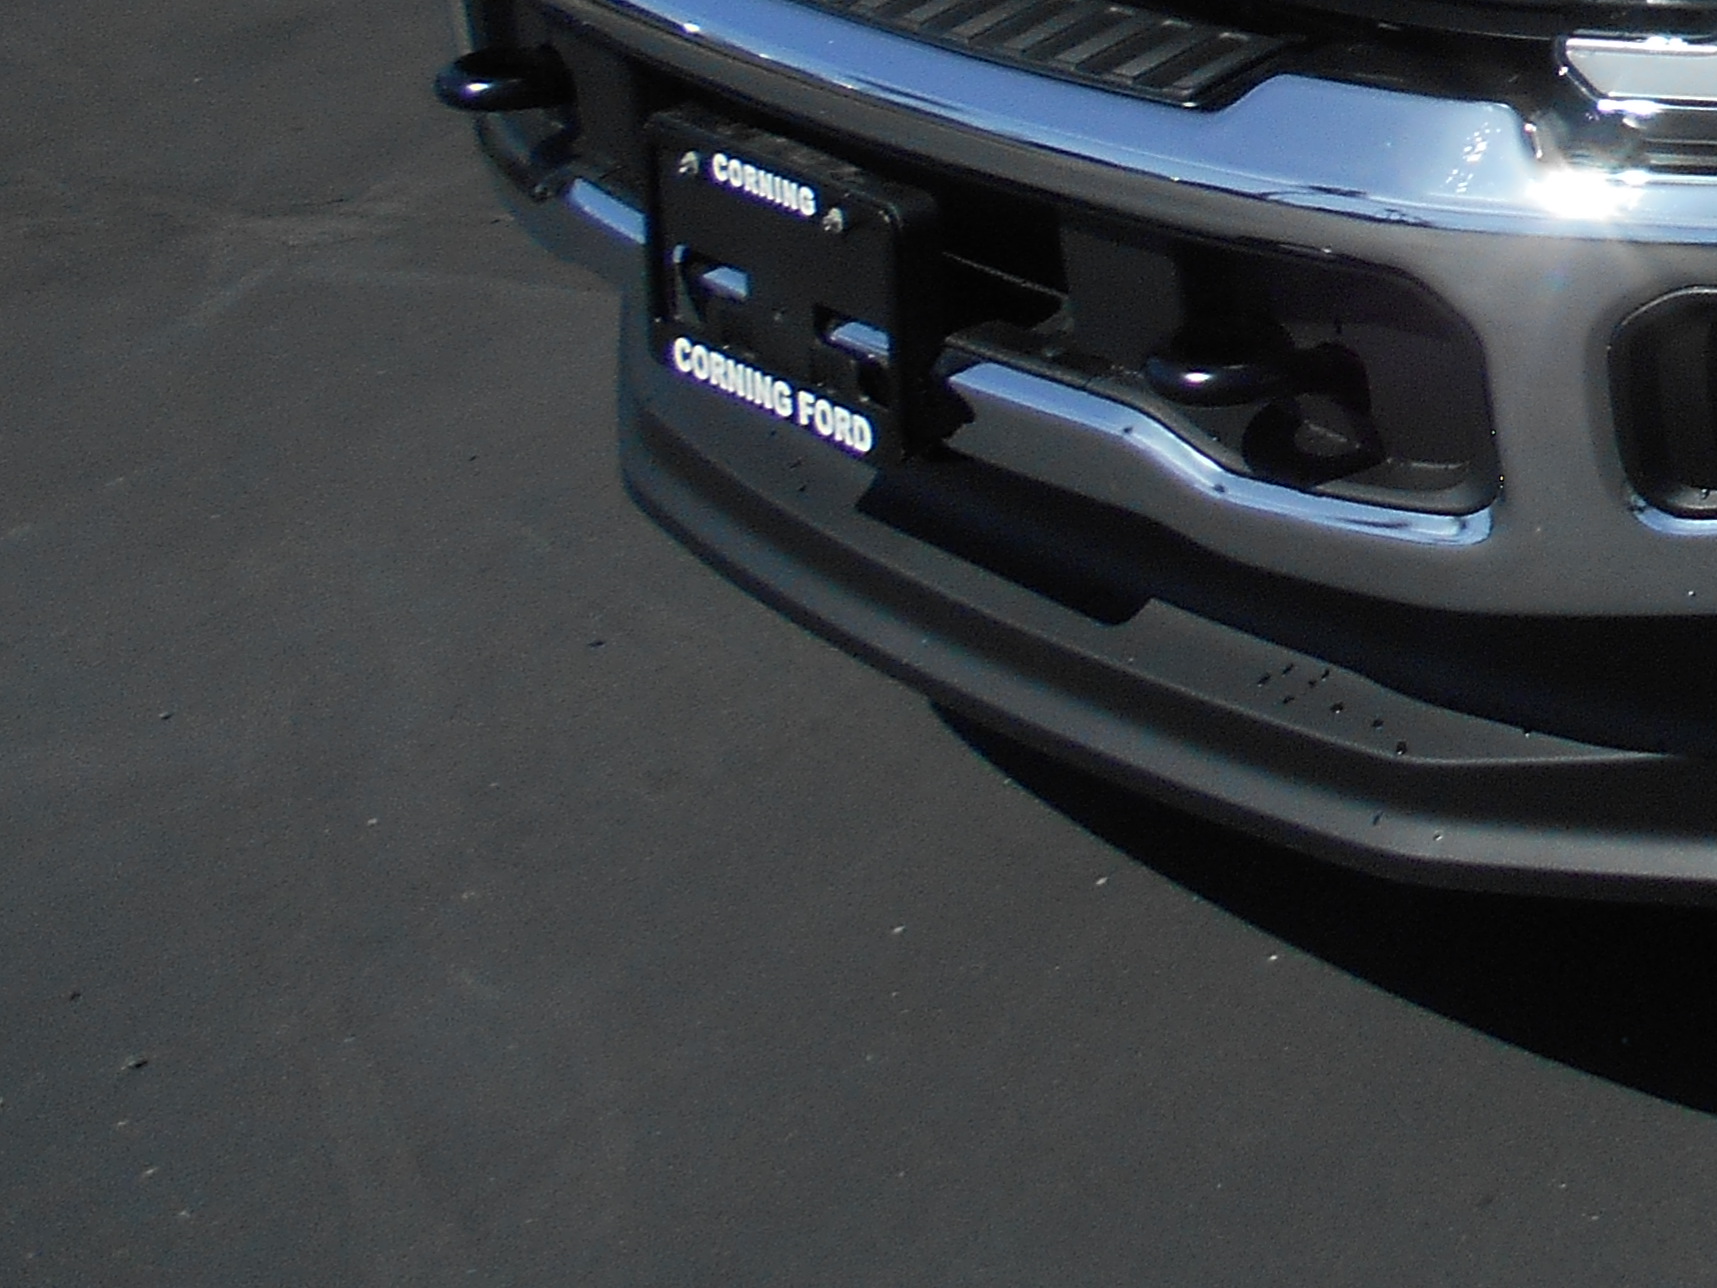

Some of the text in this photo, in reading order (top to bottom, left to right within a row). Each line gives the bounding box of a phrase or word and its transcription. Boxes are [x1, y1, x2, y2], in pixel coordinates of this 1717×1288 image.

[711, 152, 816, 217] CORNING
[672, 336, 873, 454] CORNING FORD
